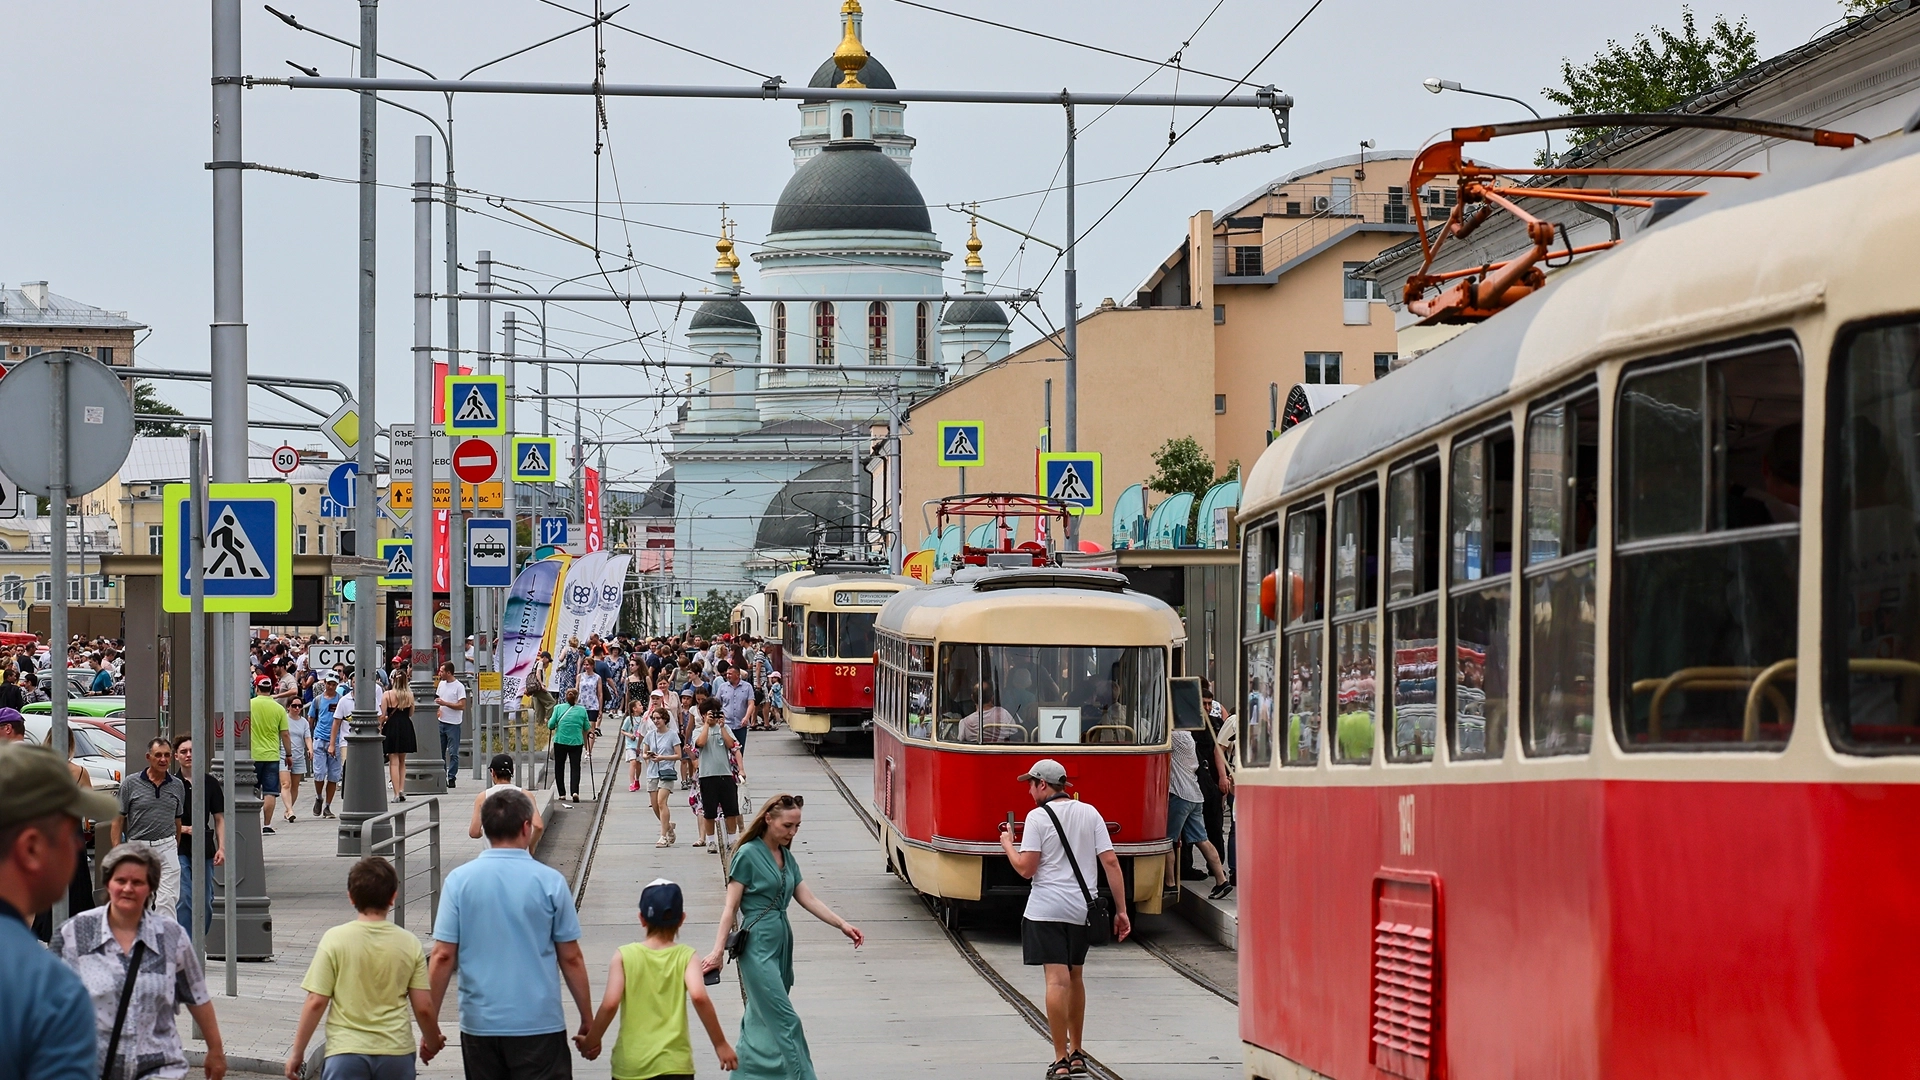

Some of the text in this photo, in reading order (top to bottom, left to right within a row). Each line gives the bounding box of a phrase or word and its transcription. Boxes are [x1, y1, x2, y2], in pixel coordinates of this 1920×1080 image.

[278, 454, 293, 465] 50
[836, 592, 850, 603] 24
[514, 589, 536, 654] CHRISTINA
[319, 649, 355, 666] СТО
[835, 665, 857, 677] 378
[1051, 715, 1069, 740] 7
